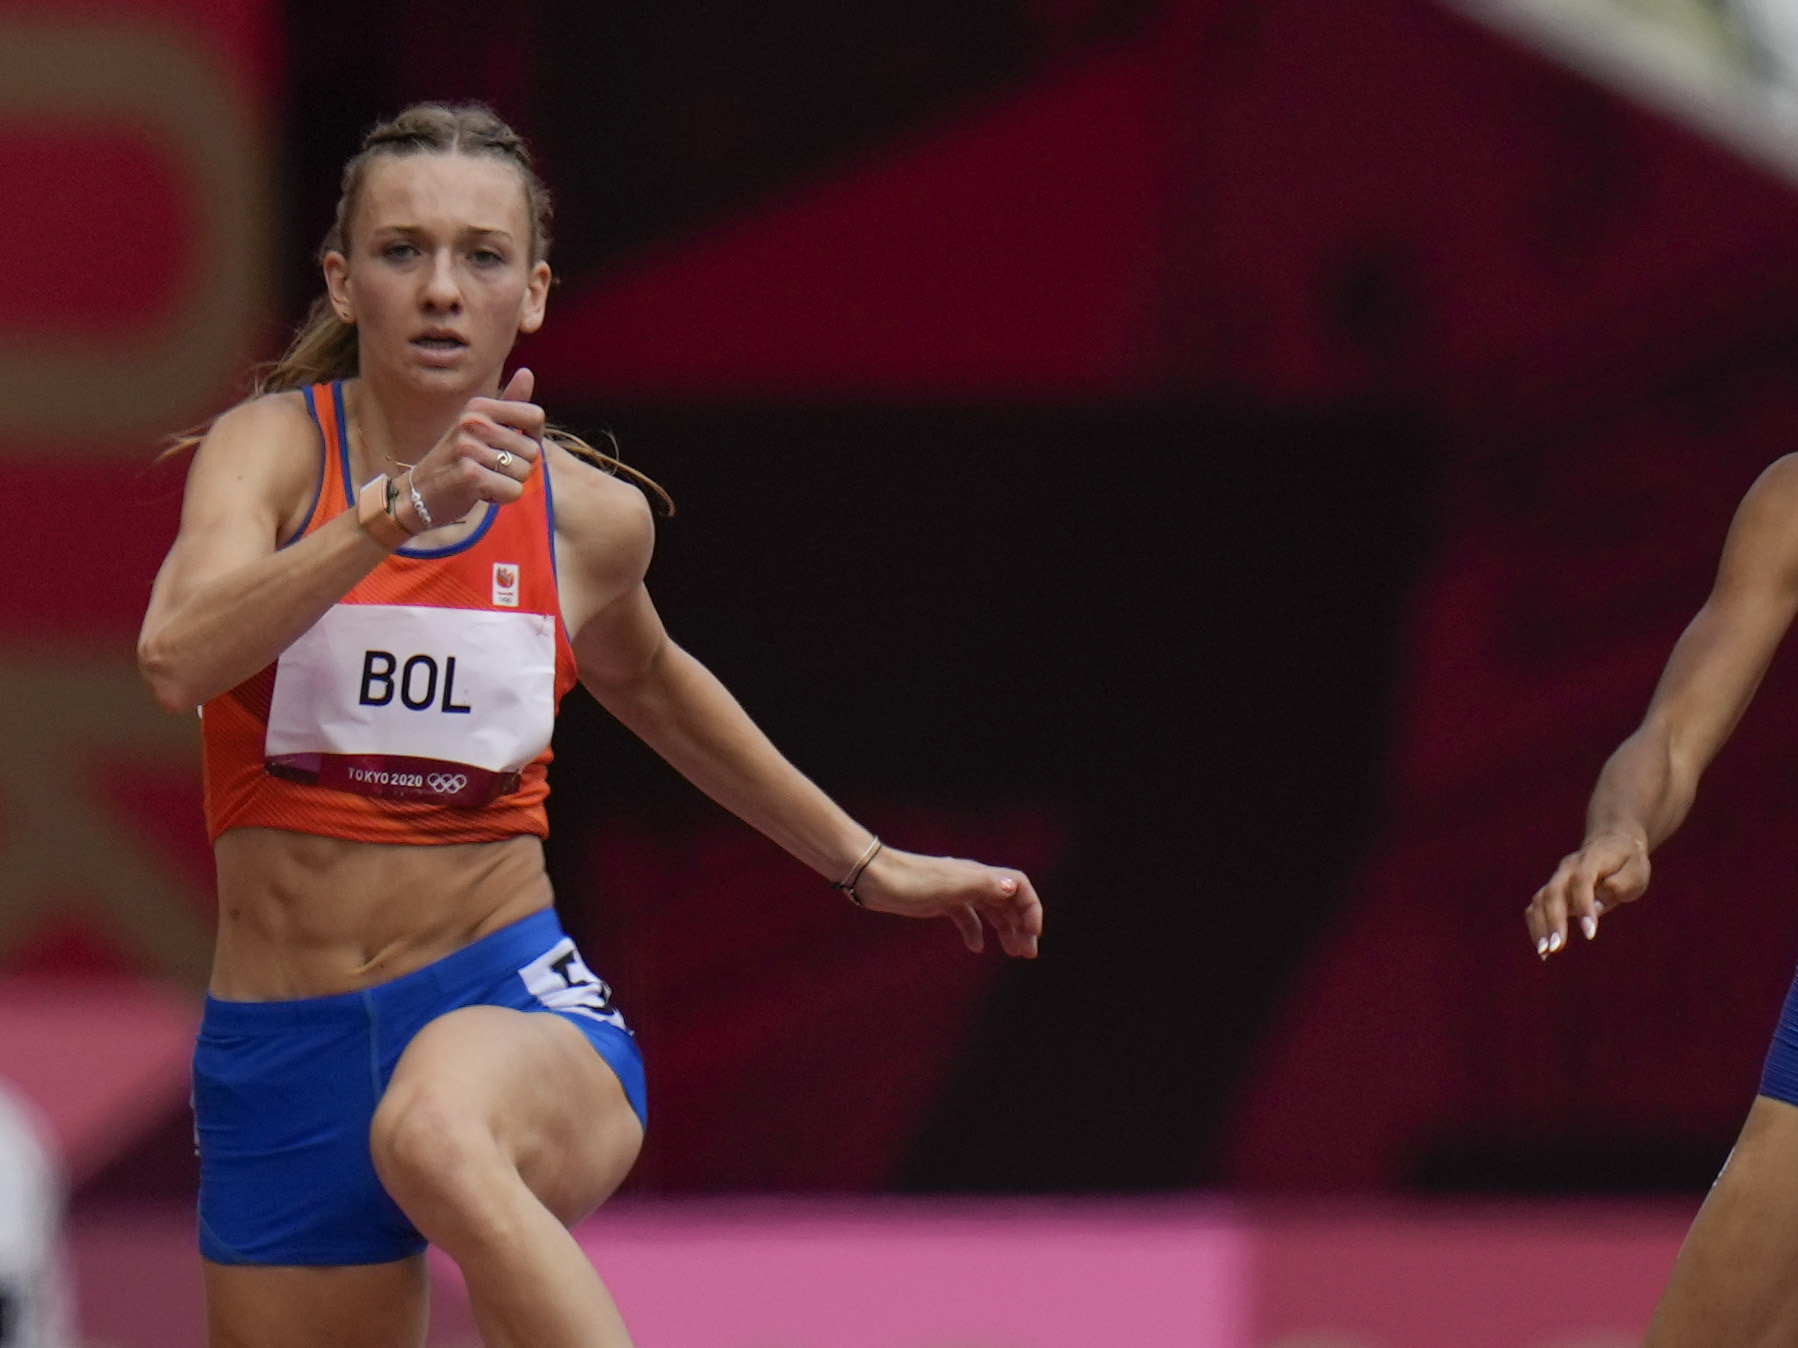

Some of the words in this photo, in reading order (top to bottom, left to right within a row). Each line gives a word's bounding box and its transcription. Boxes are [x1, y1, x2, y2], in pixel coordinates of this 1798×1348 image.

[358, 650, 471, 714] BOL
[348, 767, 389, 785] TOKYO
[390, 772, 423, 788] 2020
